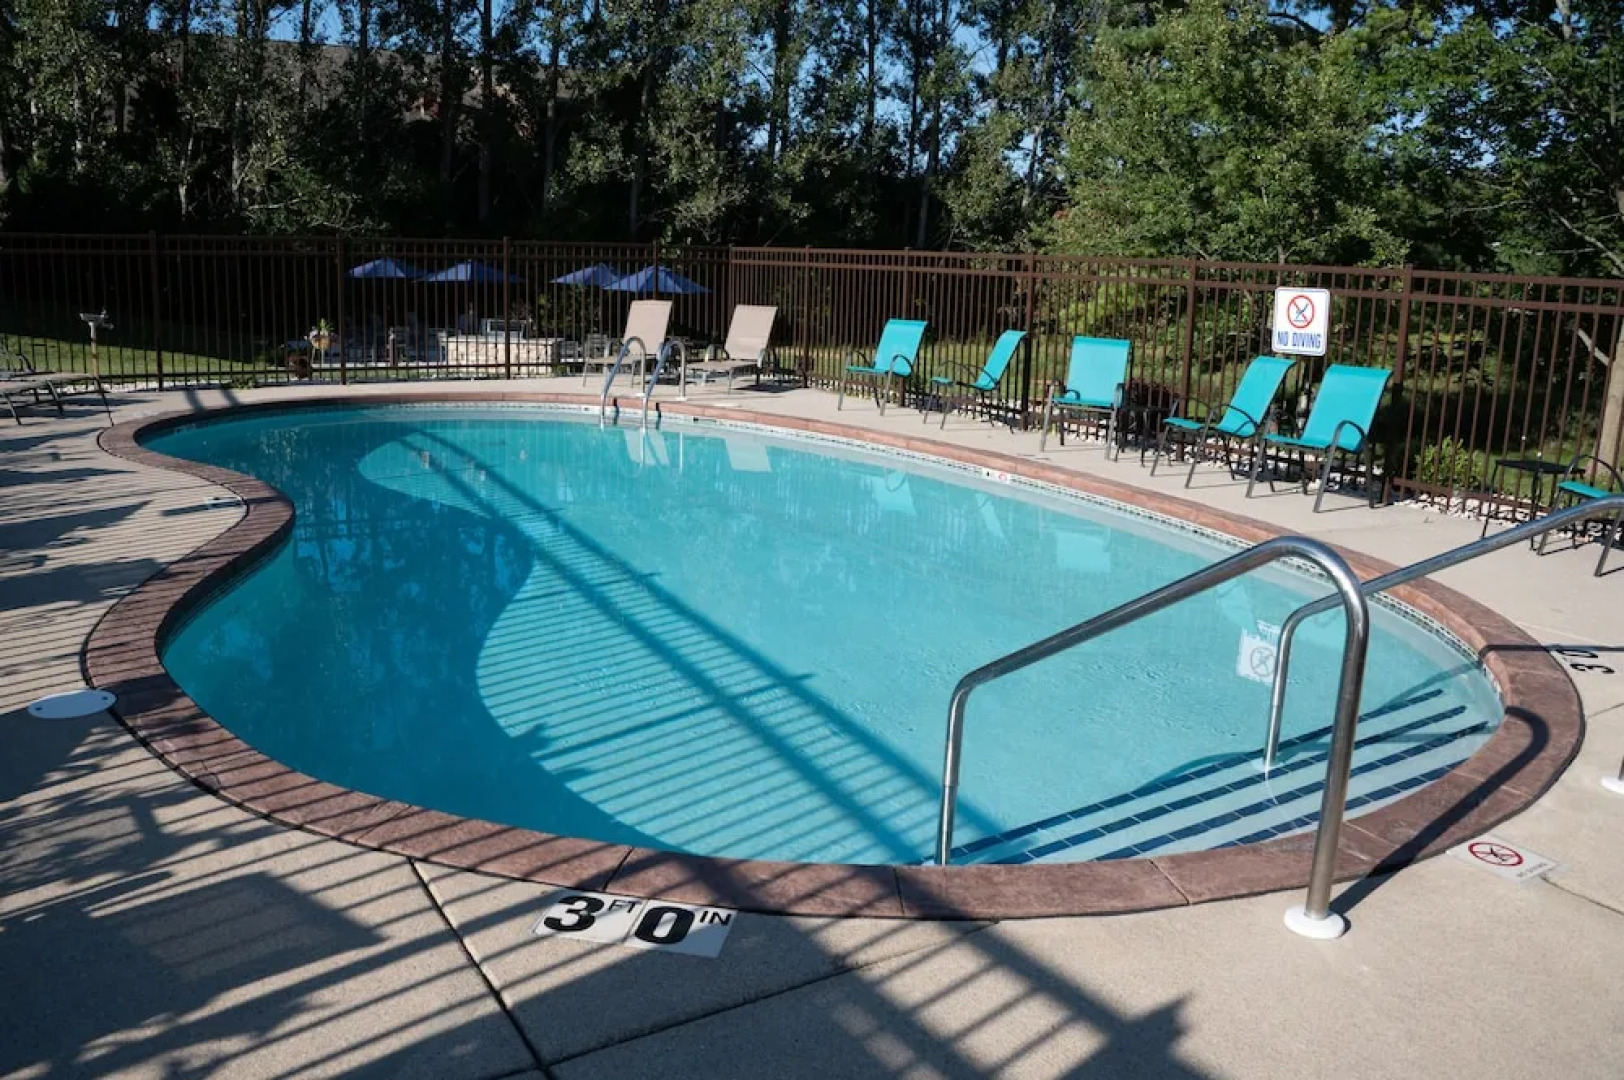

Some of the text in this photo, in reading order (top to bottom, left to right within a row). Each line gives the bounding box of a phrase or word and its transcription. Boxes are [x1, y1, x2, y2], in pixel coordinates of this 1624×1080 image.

[1277, 331, 1322, 349] NO DIVING
[543, 896, 733, 944] 3 FT 0 IN
